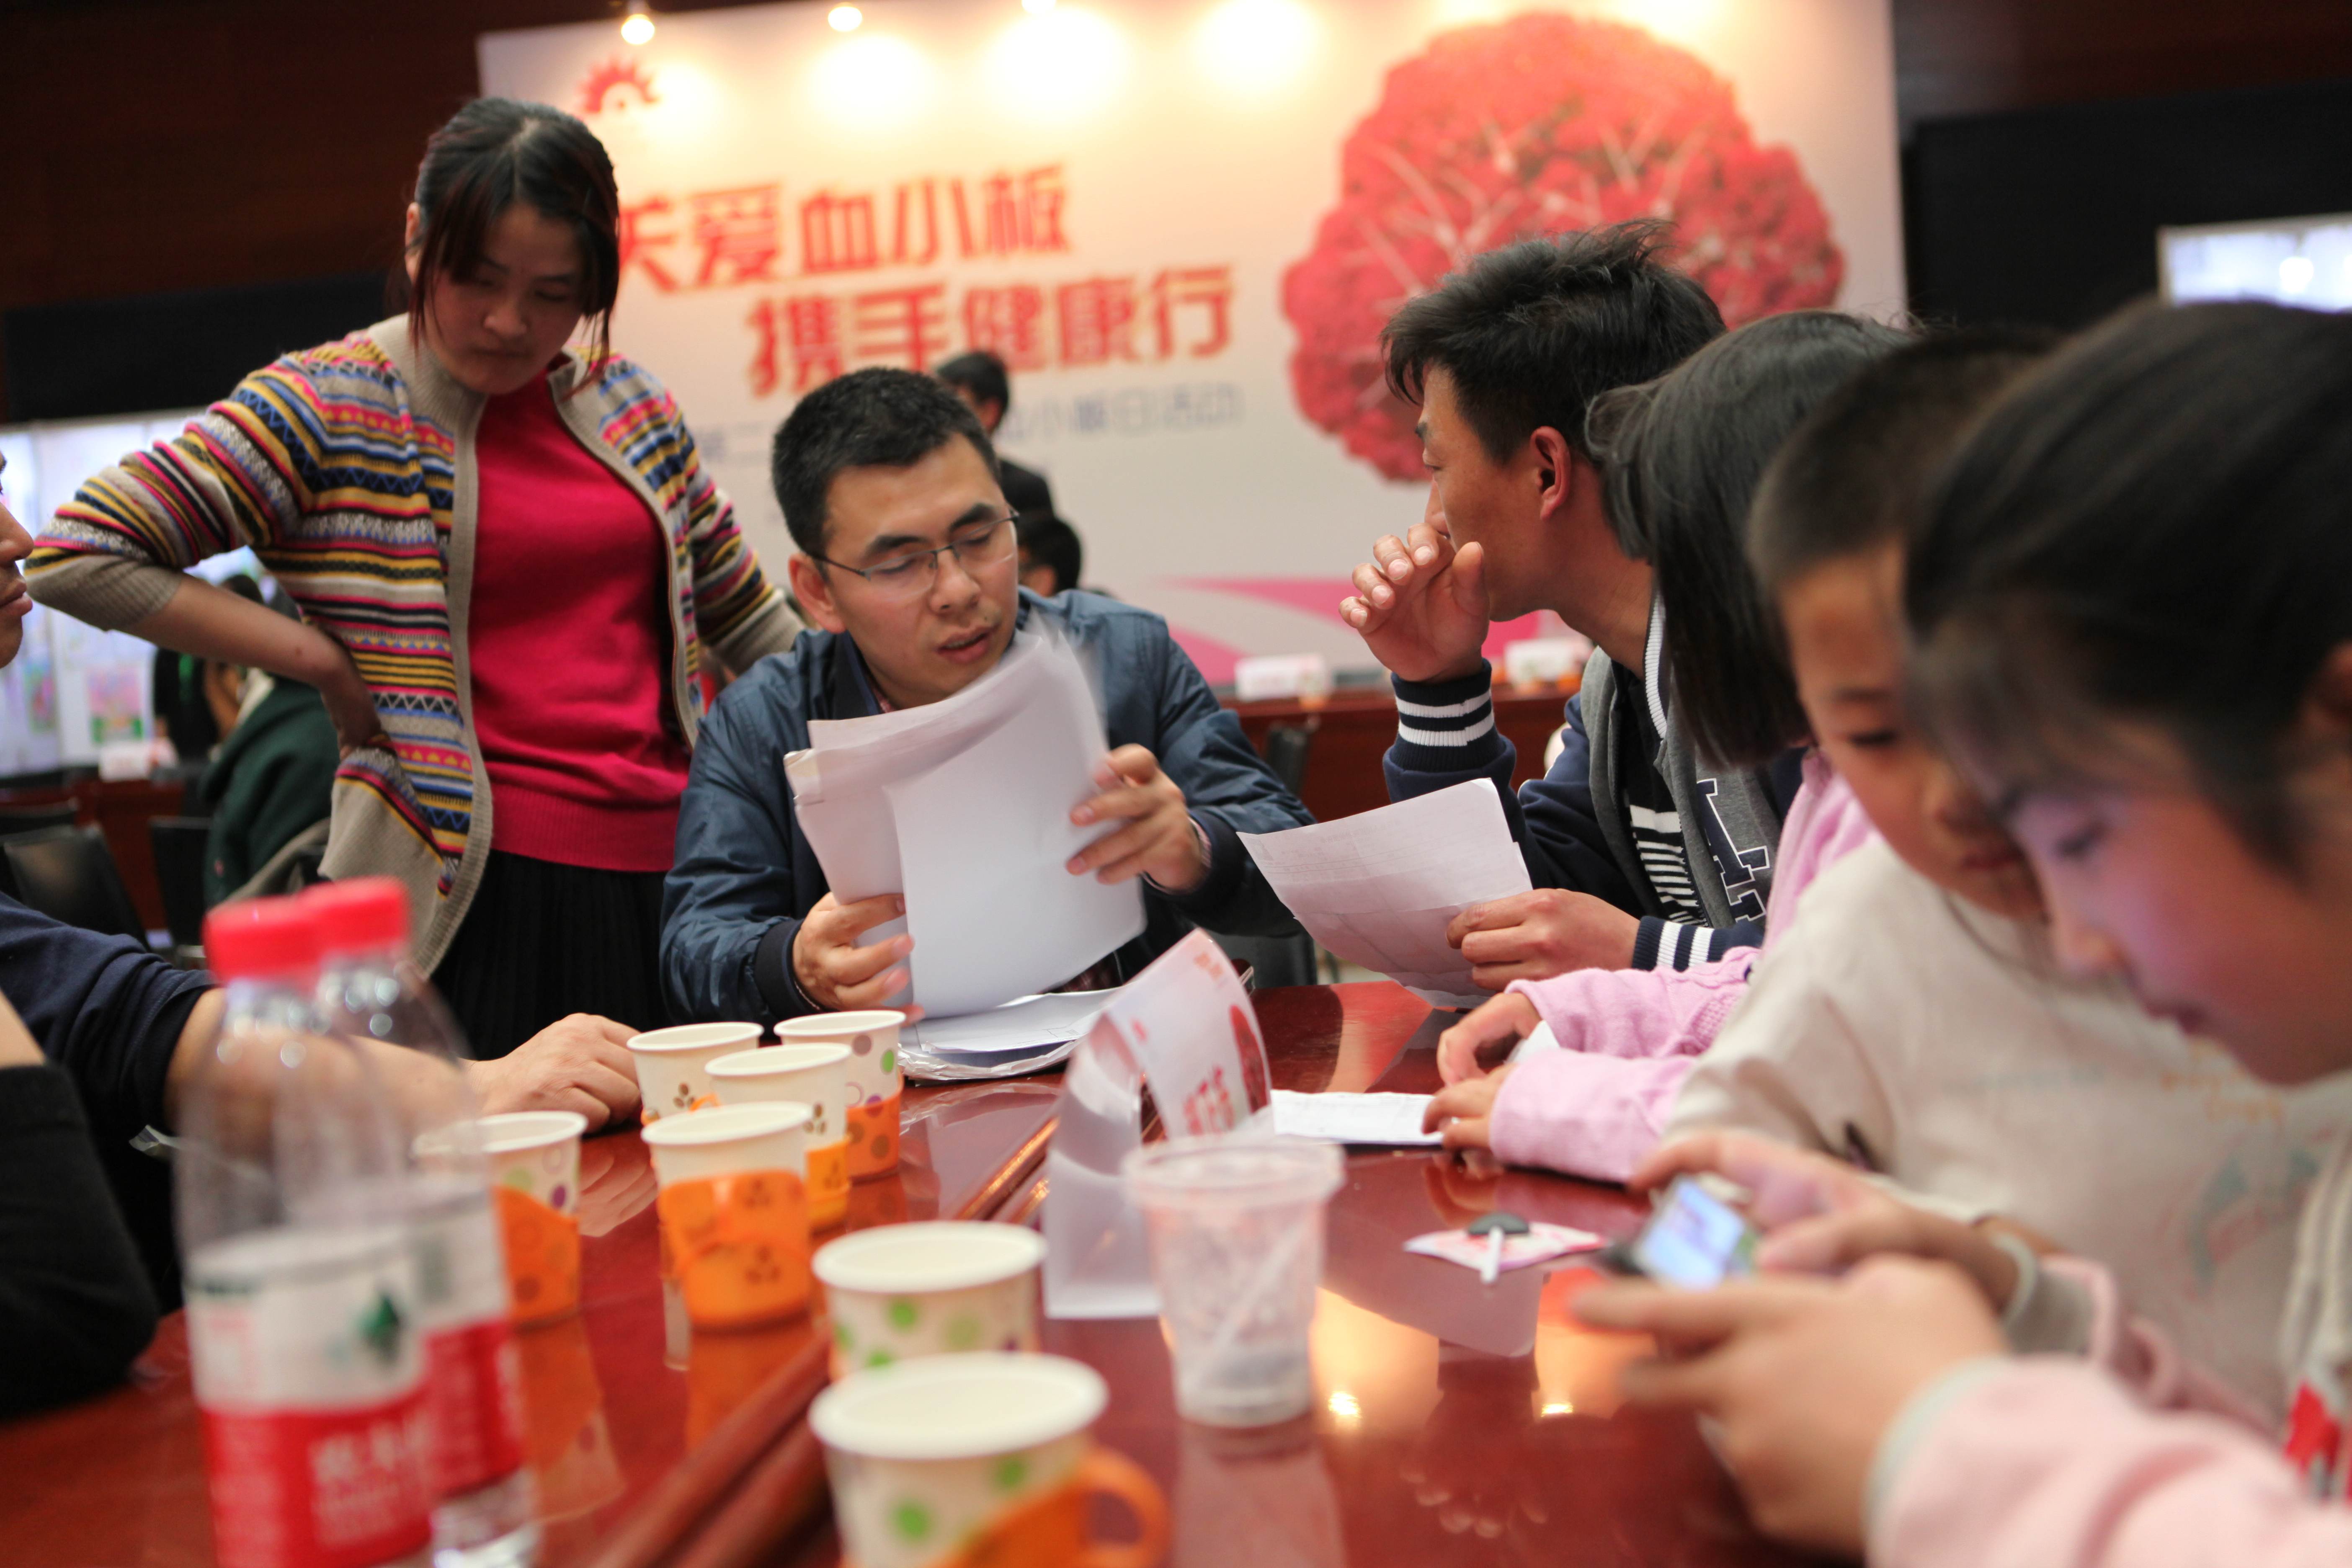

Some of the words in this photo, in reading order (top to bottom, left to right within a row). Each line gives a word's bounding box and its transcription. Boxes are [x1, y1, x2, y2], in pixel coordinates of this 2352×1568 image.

[750, 265, 1232, 398] 携手健康行
